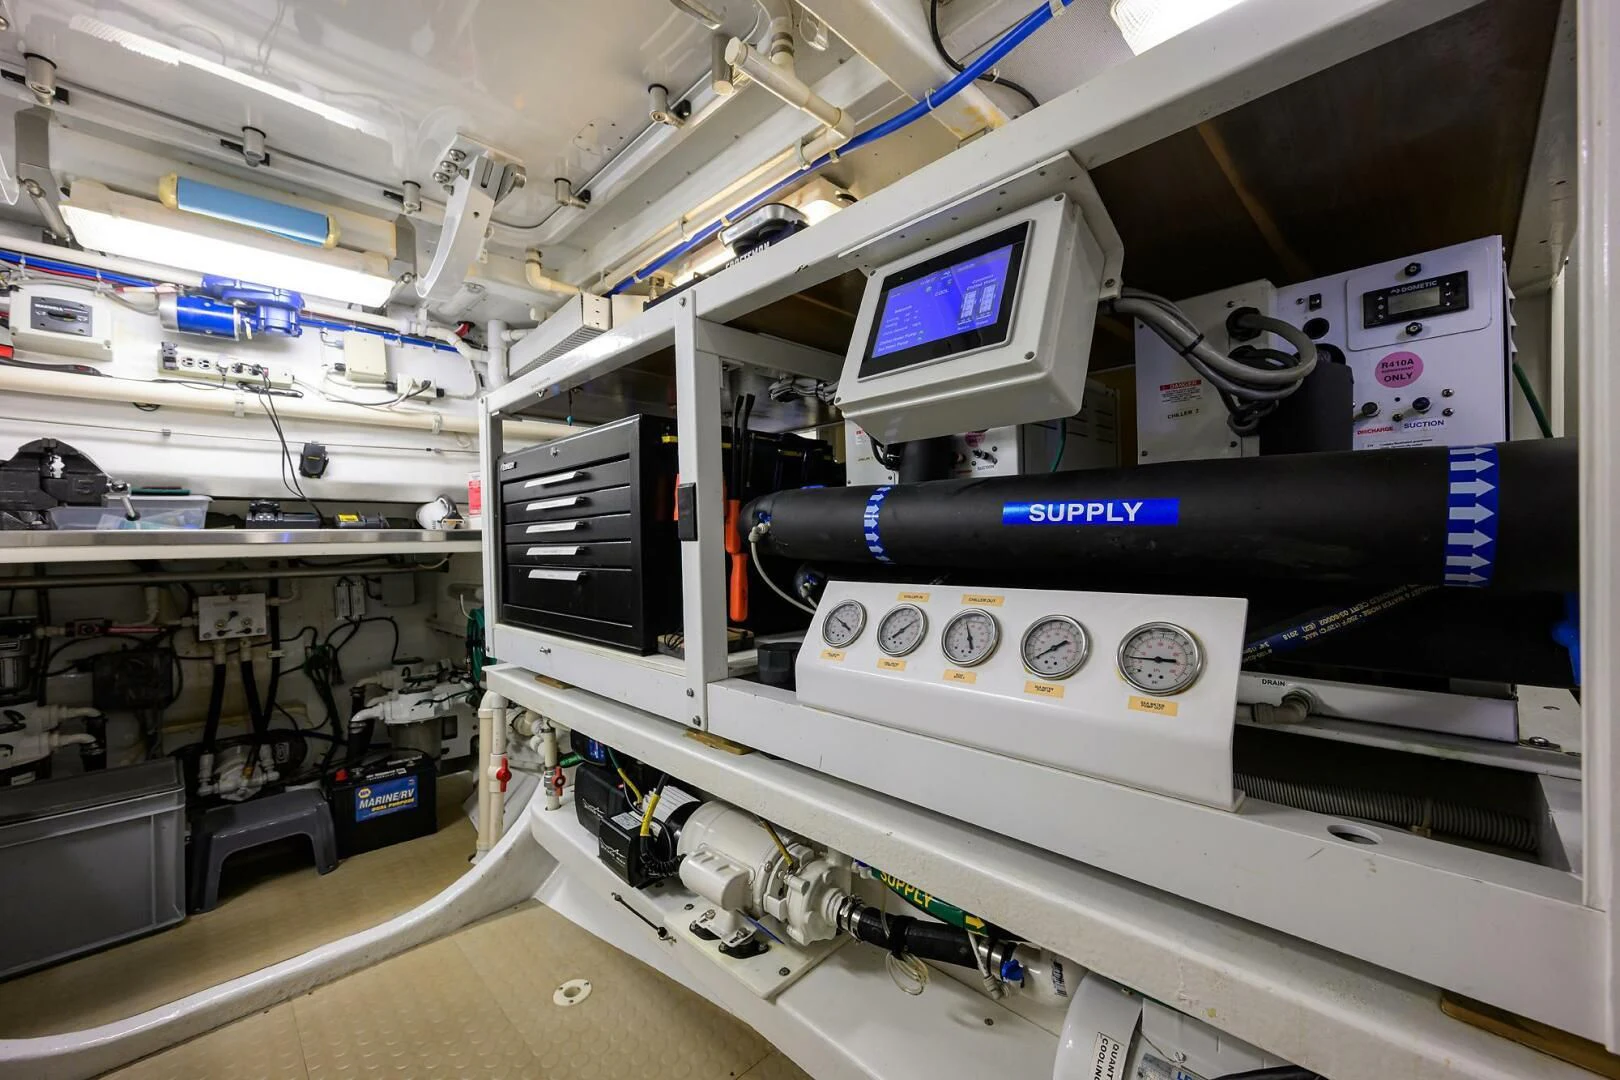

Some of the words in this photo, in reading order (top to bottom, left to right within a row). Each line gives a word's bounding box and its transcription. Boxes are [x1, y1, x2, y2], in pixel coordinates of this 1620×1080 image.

[1401, 280, 1438, 293] DOMETIC
[1381, 358, 1414, 369] R410A
[1384, 372, 1413, 382] ONLY
[1404, 419, 1444, 429] SUCTION
[1028, 501, 1143, 522] SUPPLY
[1261, 678, 1286, 687] DRAIN
[359, 788, 415, 809] MARINE/RV
